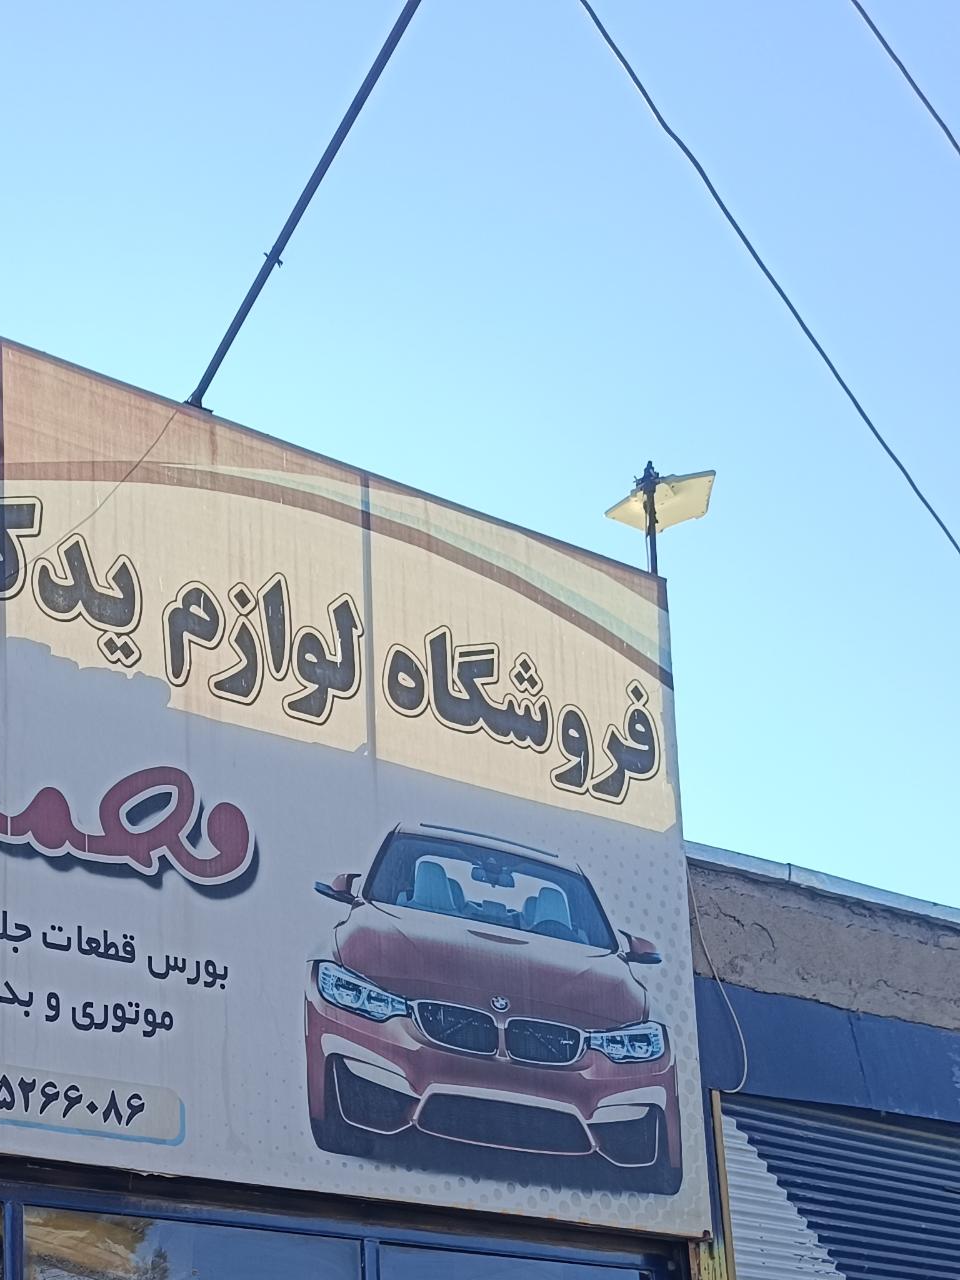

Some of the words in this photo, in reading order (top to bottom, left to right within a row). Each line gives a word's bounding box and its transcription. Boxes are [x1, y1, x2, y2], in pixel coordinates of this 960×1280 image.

[162, 572, 365, 724] لوازم
[383, 625, 663, 804] فروشگاه
[41, 924, 136, 964] قطعات
[146, 952, 230, 991] بورس
[44, 991, 61, 1023] و
[70, 999, 175, 1038] موتوری
